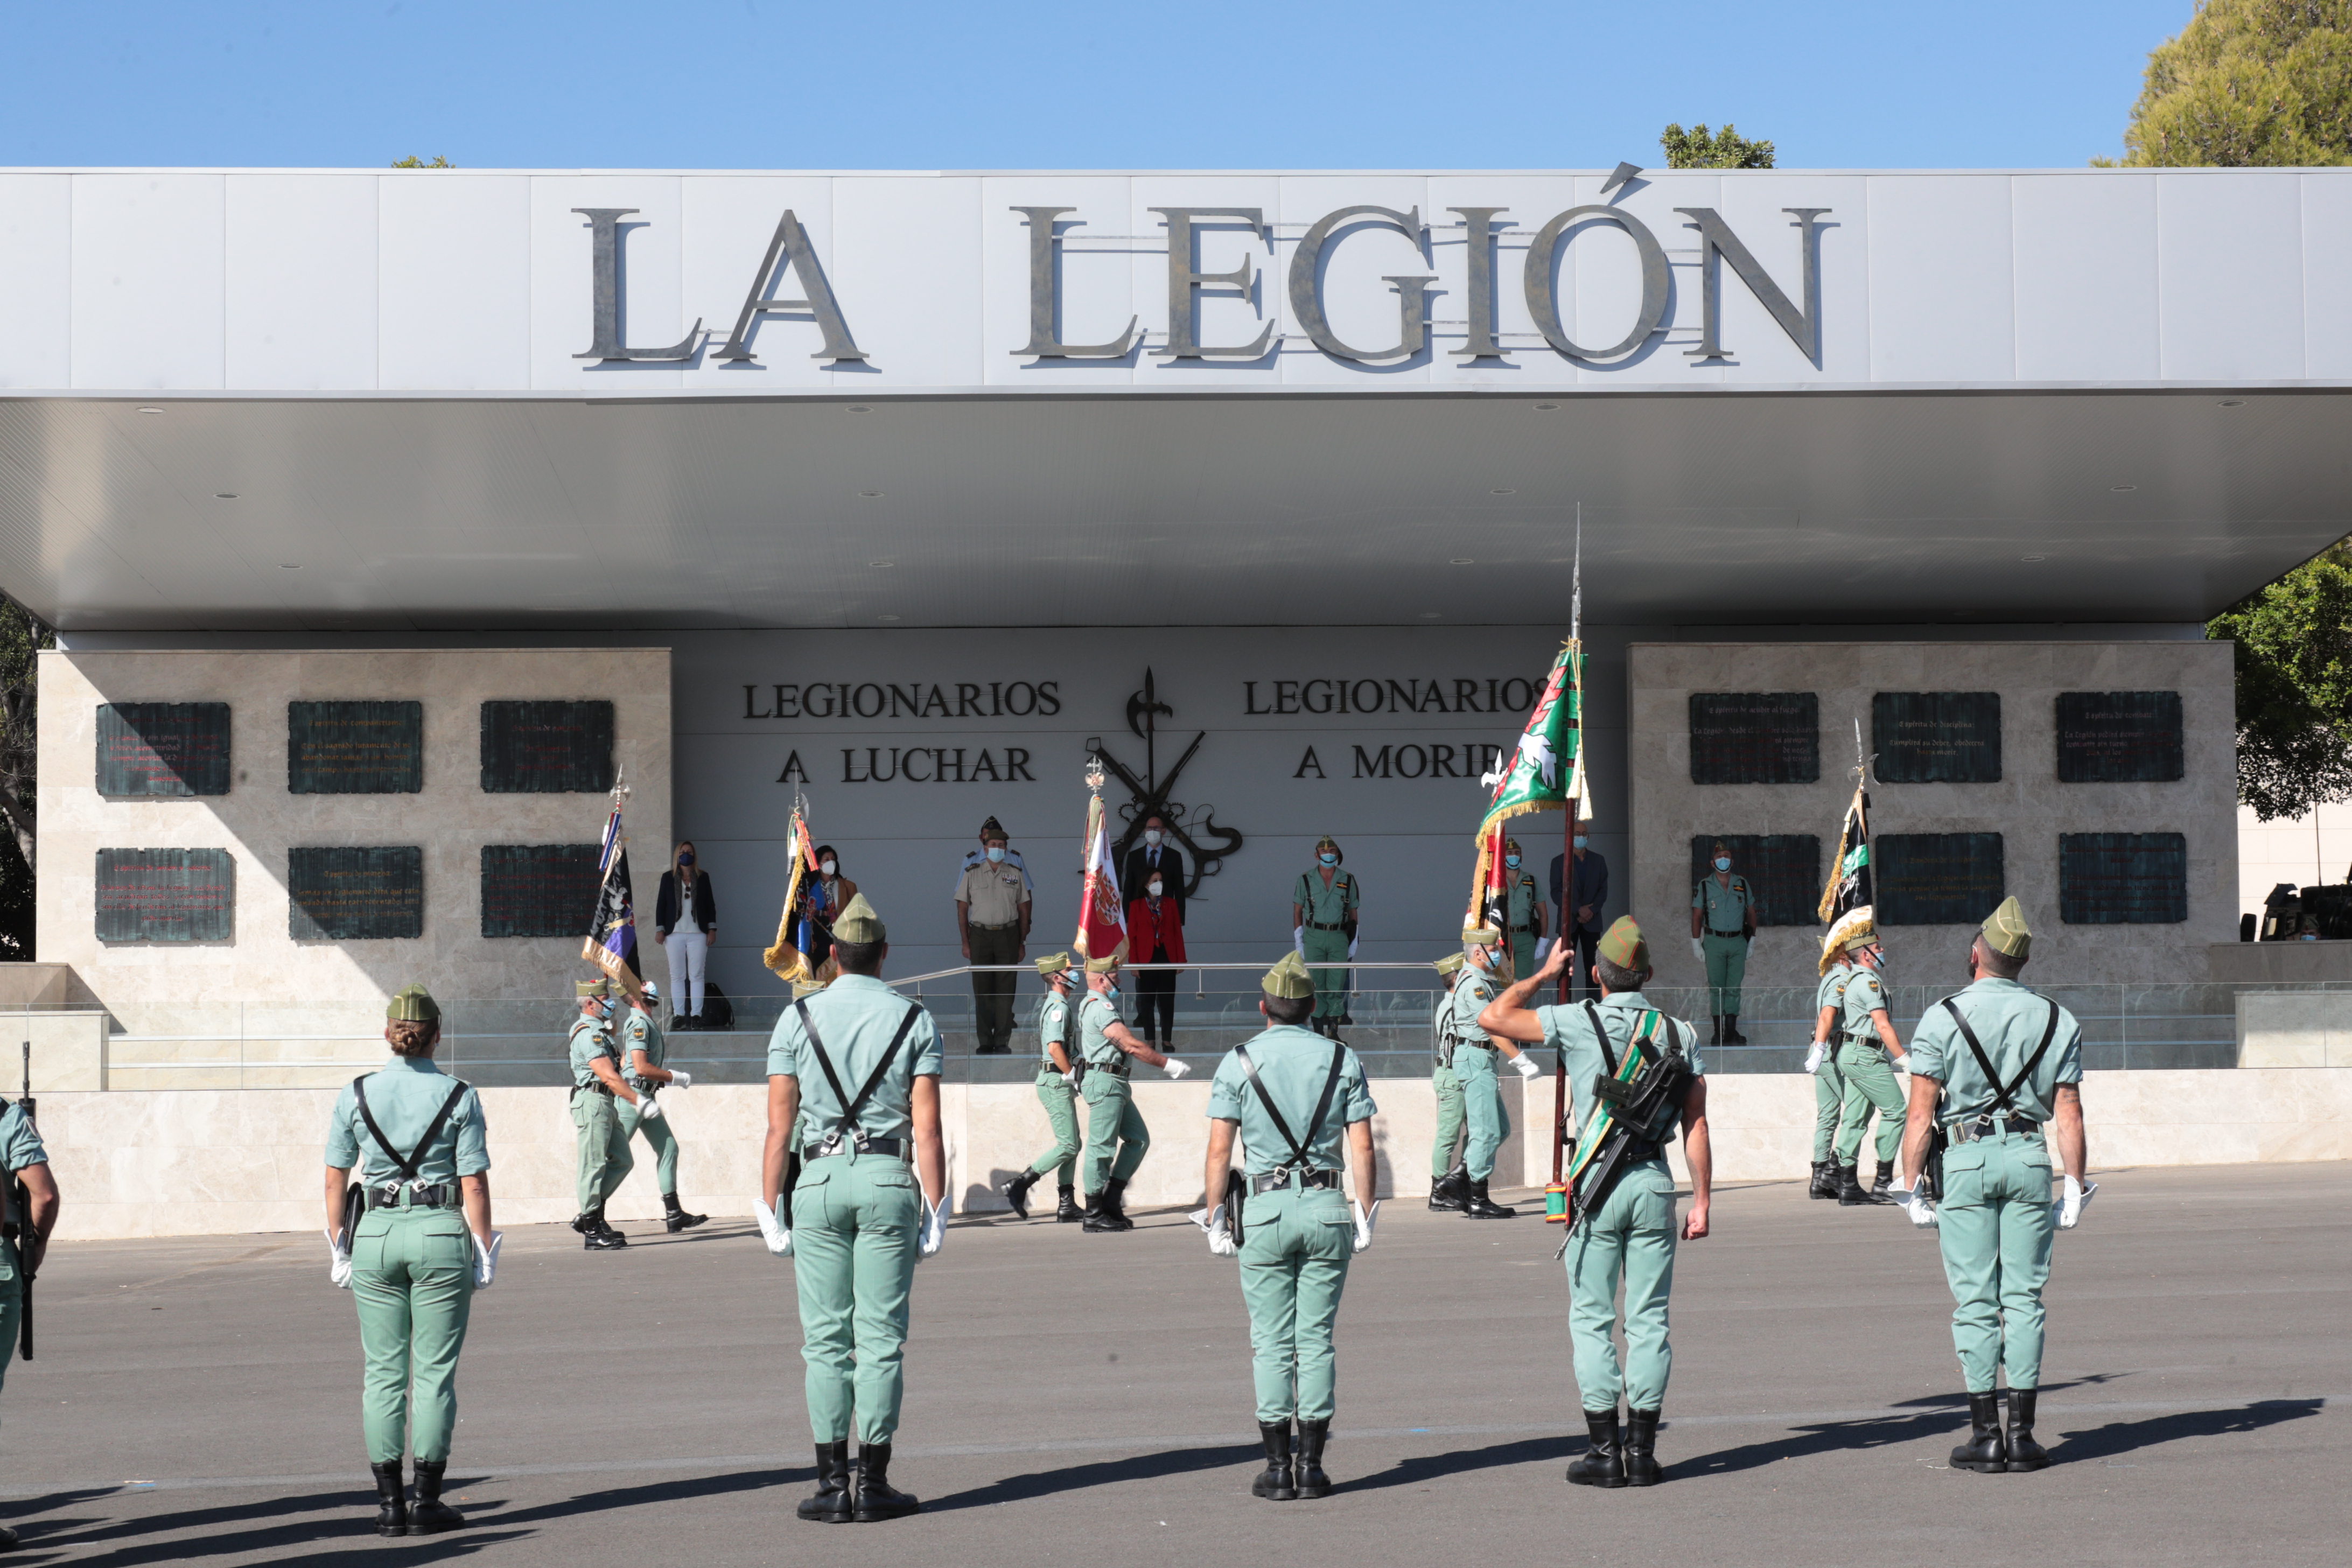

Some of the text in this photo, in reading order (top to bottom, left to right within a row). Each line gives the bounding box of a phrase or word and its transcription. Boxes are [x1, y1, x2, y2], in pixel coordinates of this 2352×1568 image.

[571, 162, 1832, 361] LA LEGIÓN
[743, 681, 1061, 719] LEGIONARIOS
[775, 747, 1037, 783] A LUCHAR
[1292, 744, 1327, 779] A
